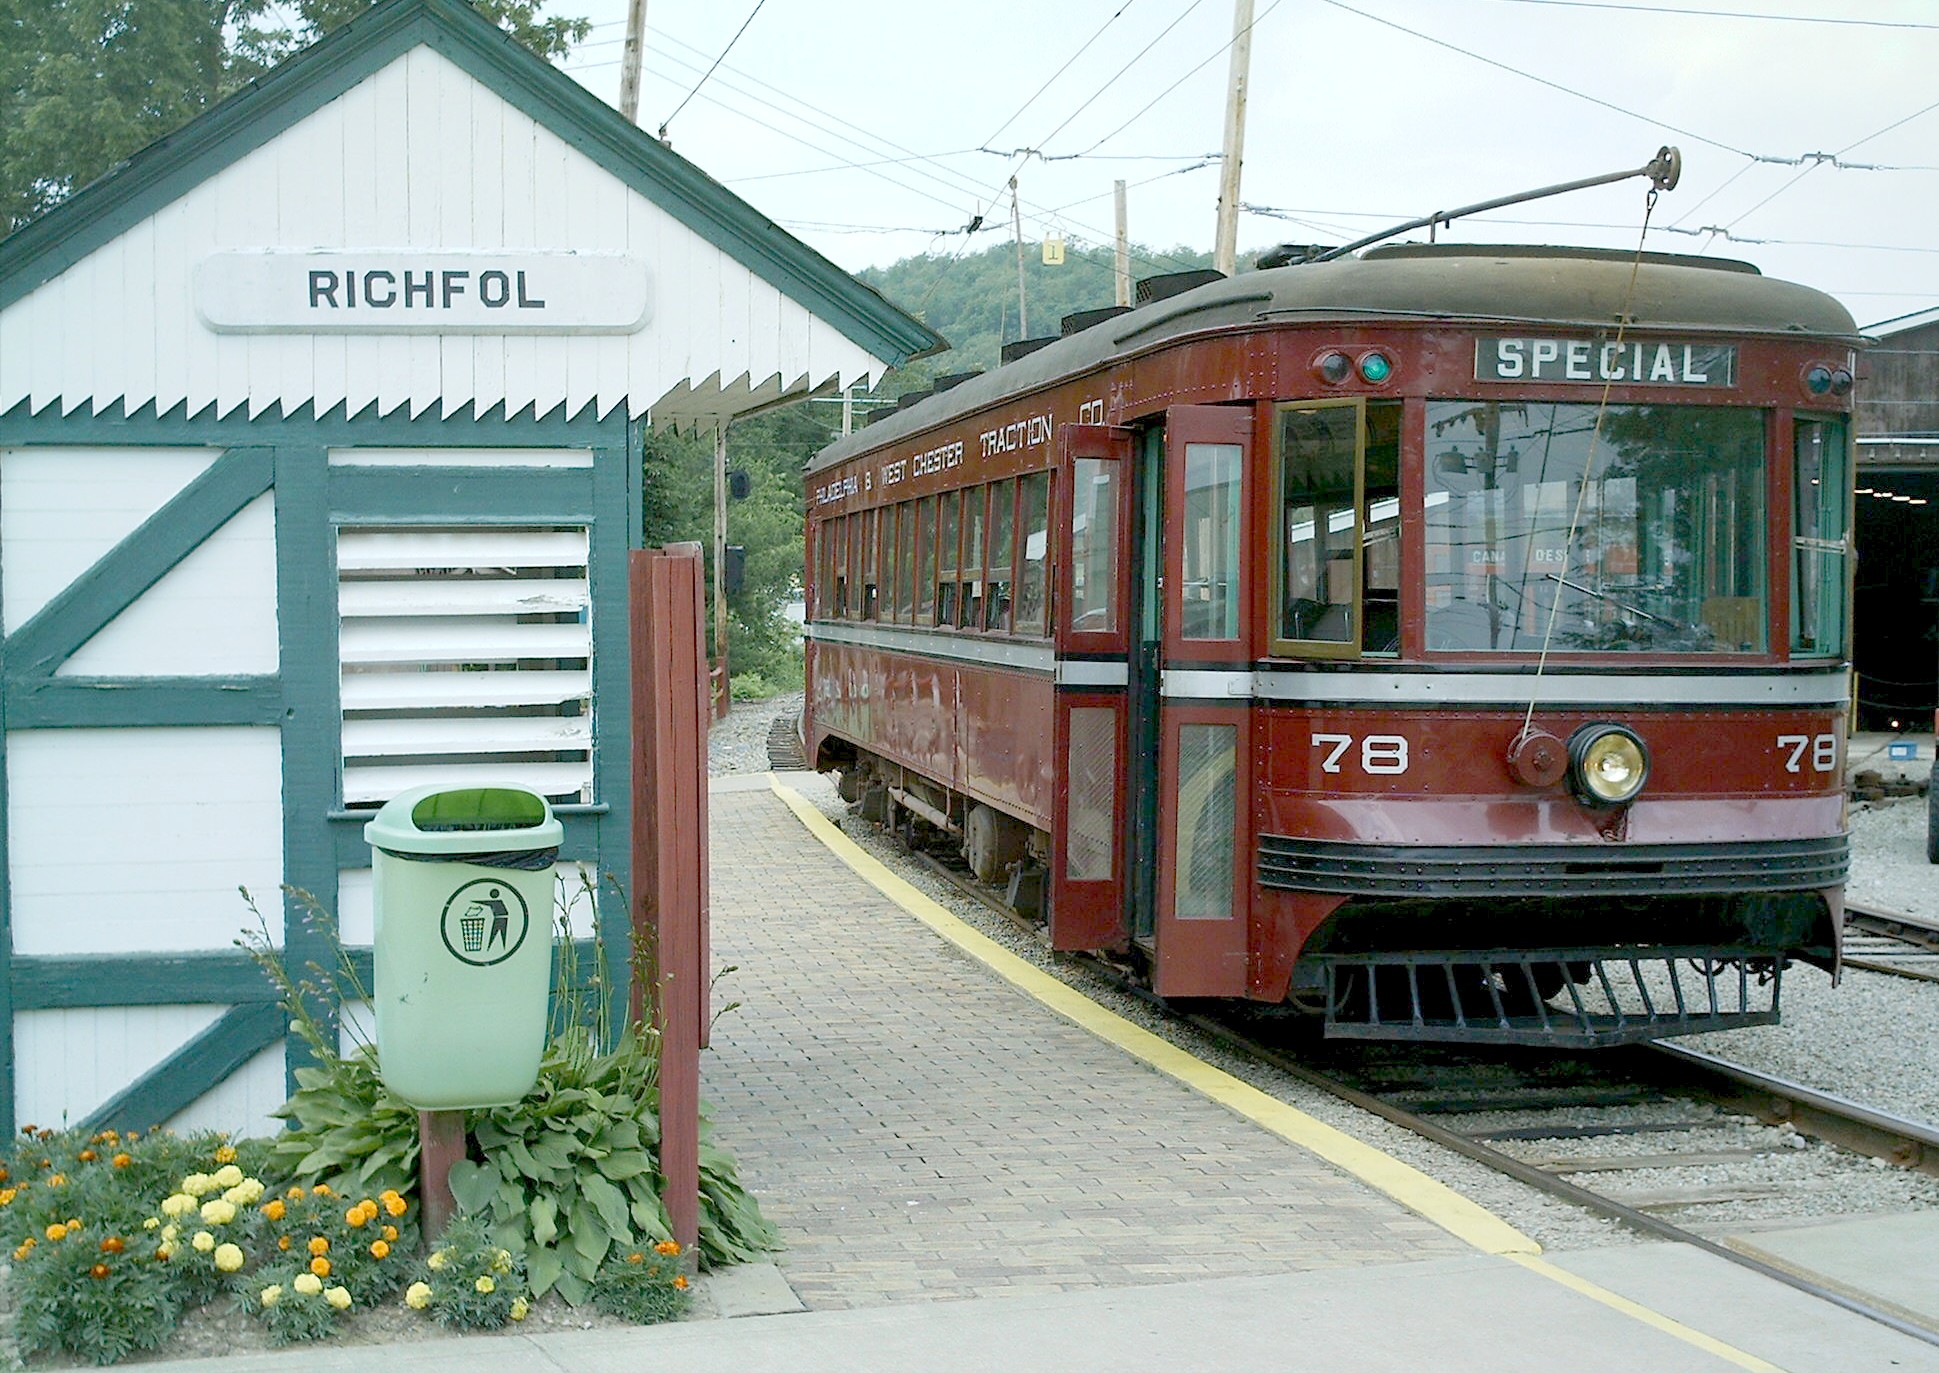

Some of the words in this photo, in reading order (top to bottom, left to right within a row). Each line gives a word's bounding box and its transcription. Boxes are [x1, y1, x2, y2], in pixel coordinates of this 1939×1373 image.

[308, 270, 546, 309] RICHFOL
[1497, 339, 1708, 383] SPECIAL
[881, 459, 907, 486] WEST
[912, 441, 964, 478] CHESTER
[980, 414, 1054, 458] TRACTION
[1311, 733, 1409, 775] 78
[1776, 733, 1837, 773] 78
